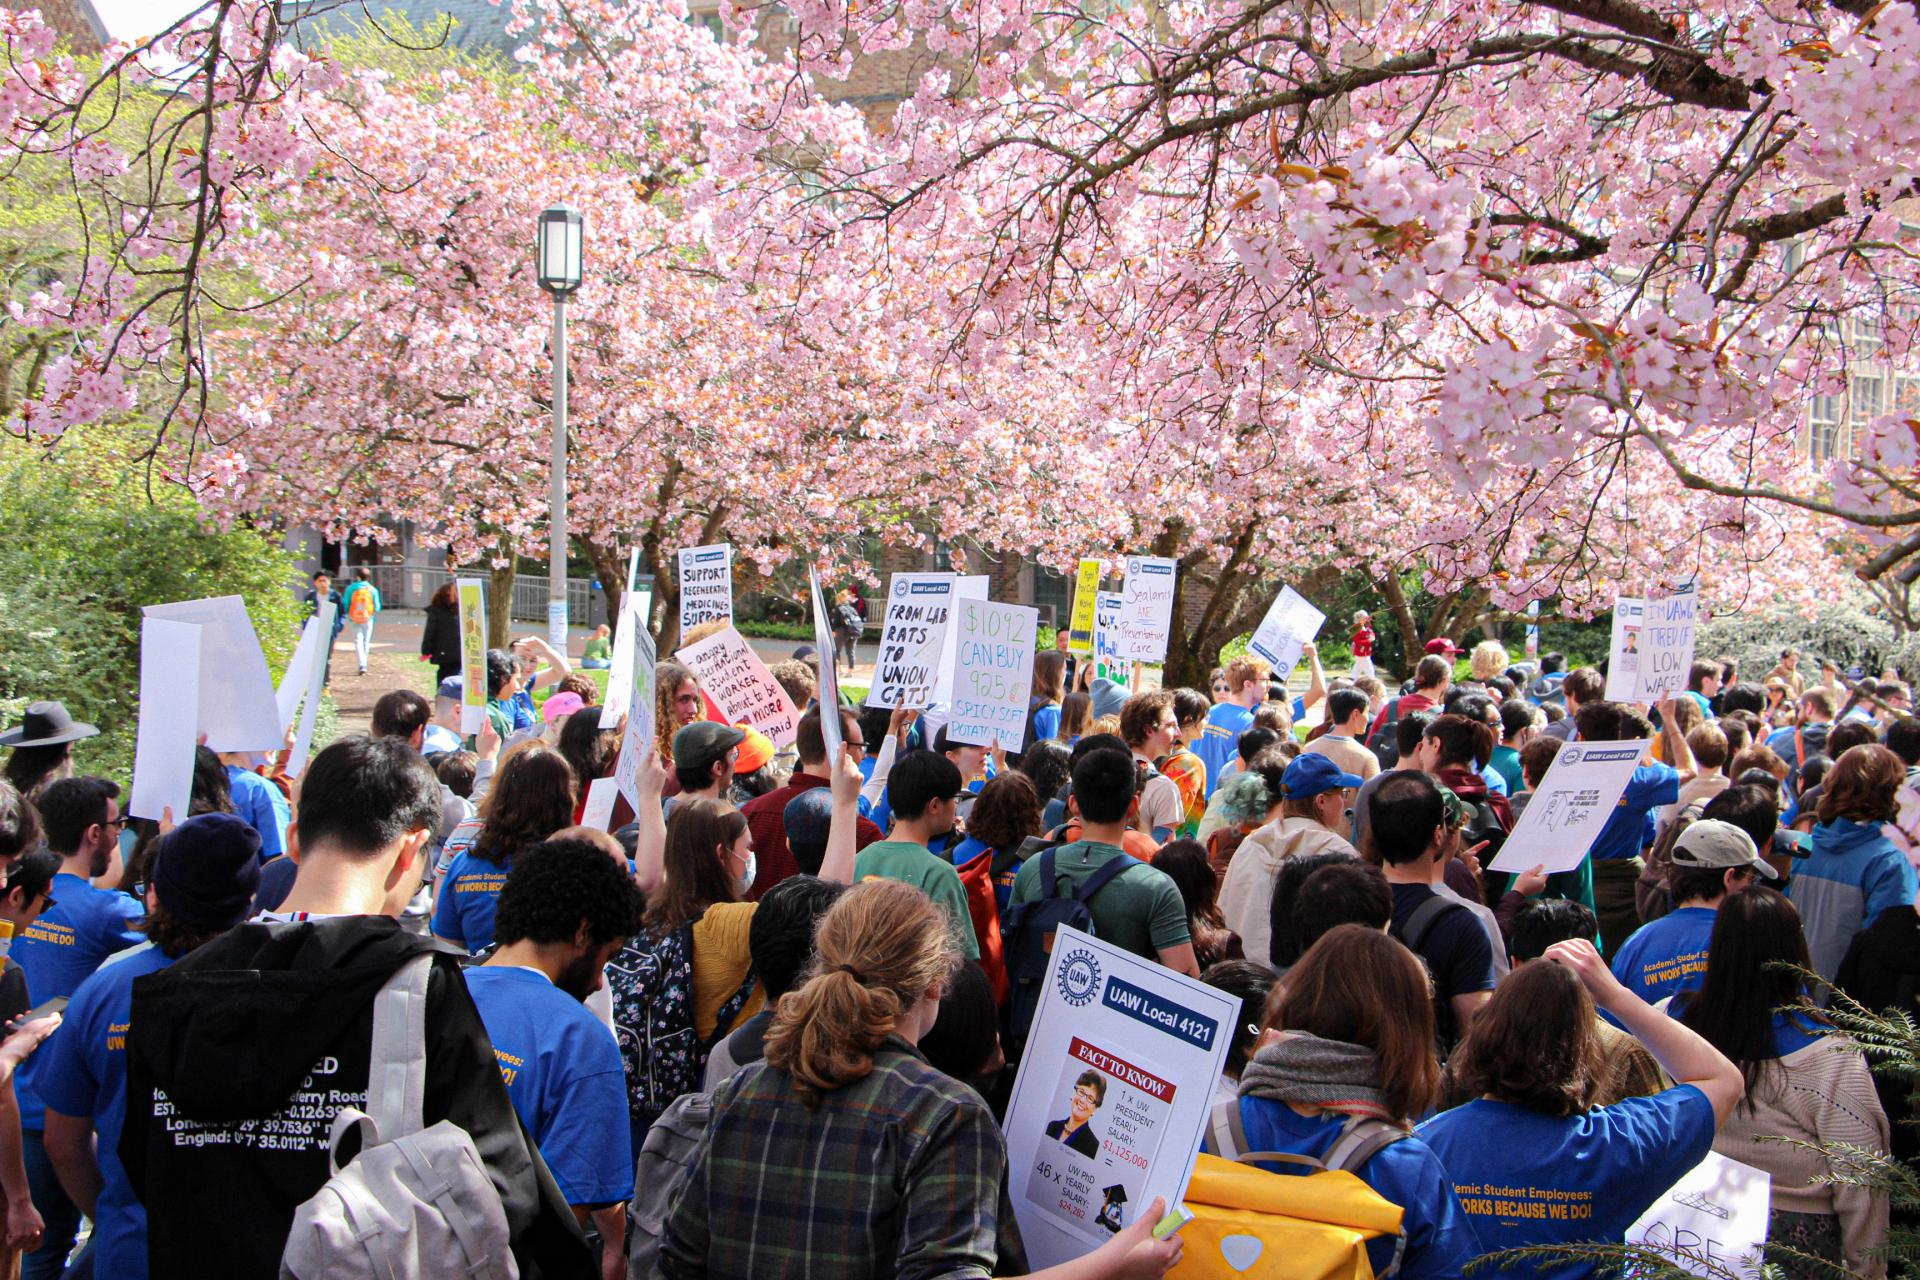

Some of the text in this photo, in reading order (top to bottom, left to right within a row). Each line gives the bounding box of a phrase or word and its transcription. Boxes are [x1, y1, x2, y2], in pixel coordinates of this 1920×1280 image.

[684, 567, 726, 582] SUPPORT
[889, 604, 947, 624] FROM LAB
[966, 604, 1025, 643] $1092
[886, 626, 928, 644] RATS
[884, 646, 904, 662] TO
[961, 640, 1024, 672] CAN BUY
[1130, 641, 1153, 654] Care
[1653, 652, 1683, 672] LOW
[718, 675, 760, 701] WORKER
[764, 683, 777, 698] be
[880, 686, 930, 704] CATS
[970, 670, 1006, 700] 925
[956, 699, 1024, 722] SPICY SOFT
[952, 720, 1020, 746] POTATO TACOS
[1602, 752, 1619, 760] Local
[1620, 752, 1636, 760] 4121
[48, 932, 58, 944] WE
[59, 934, 75, 946] DO!
[1070, 968, 1089, 986] UAW
[1644, 972, 1658, 986] UW
[1110, 986, 1211, 1042] UAW Local 4121
[1078, 1044, 1166, 1096] FACT TO KNOW
[330, 1090, 368, 1102] Road
[1121, 1090, 1126, 1100] 1
[1136, 1100, 1150, 1112] UW
[1112, 1115, 1138, 1134] YEARLY
[1115, 1103, 1155, 1129] PRESIDENT
[175, 1131, 230, 1147] England:
[1107, 1126, 1136, 1148] SALARY:
[1103, 1140, 1148, 1170] $1,125,000
[1036, 1161, 1052, 1178] 46
[1068, 1164, 1096, 1184] UW PhD
[1065, 1175, 1091, 1196] YEARLY
[1484, 1184, 1526, 1198] Student
[1529, 1187, 1592, 1202] Employees:
[1062, 1187, 1090, 1208] SALARY:
[1058, 1199, 1086, 1219] $24,282
[1495, 1201, 1546, 1218] BECAUSE
[1548, 1204, 1568, 1220] WE
[1570, 1203, 1592, 1220] DO!
